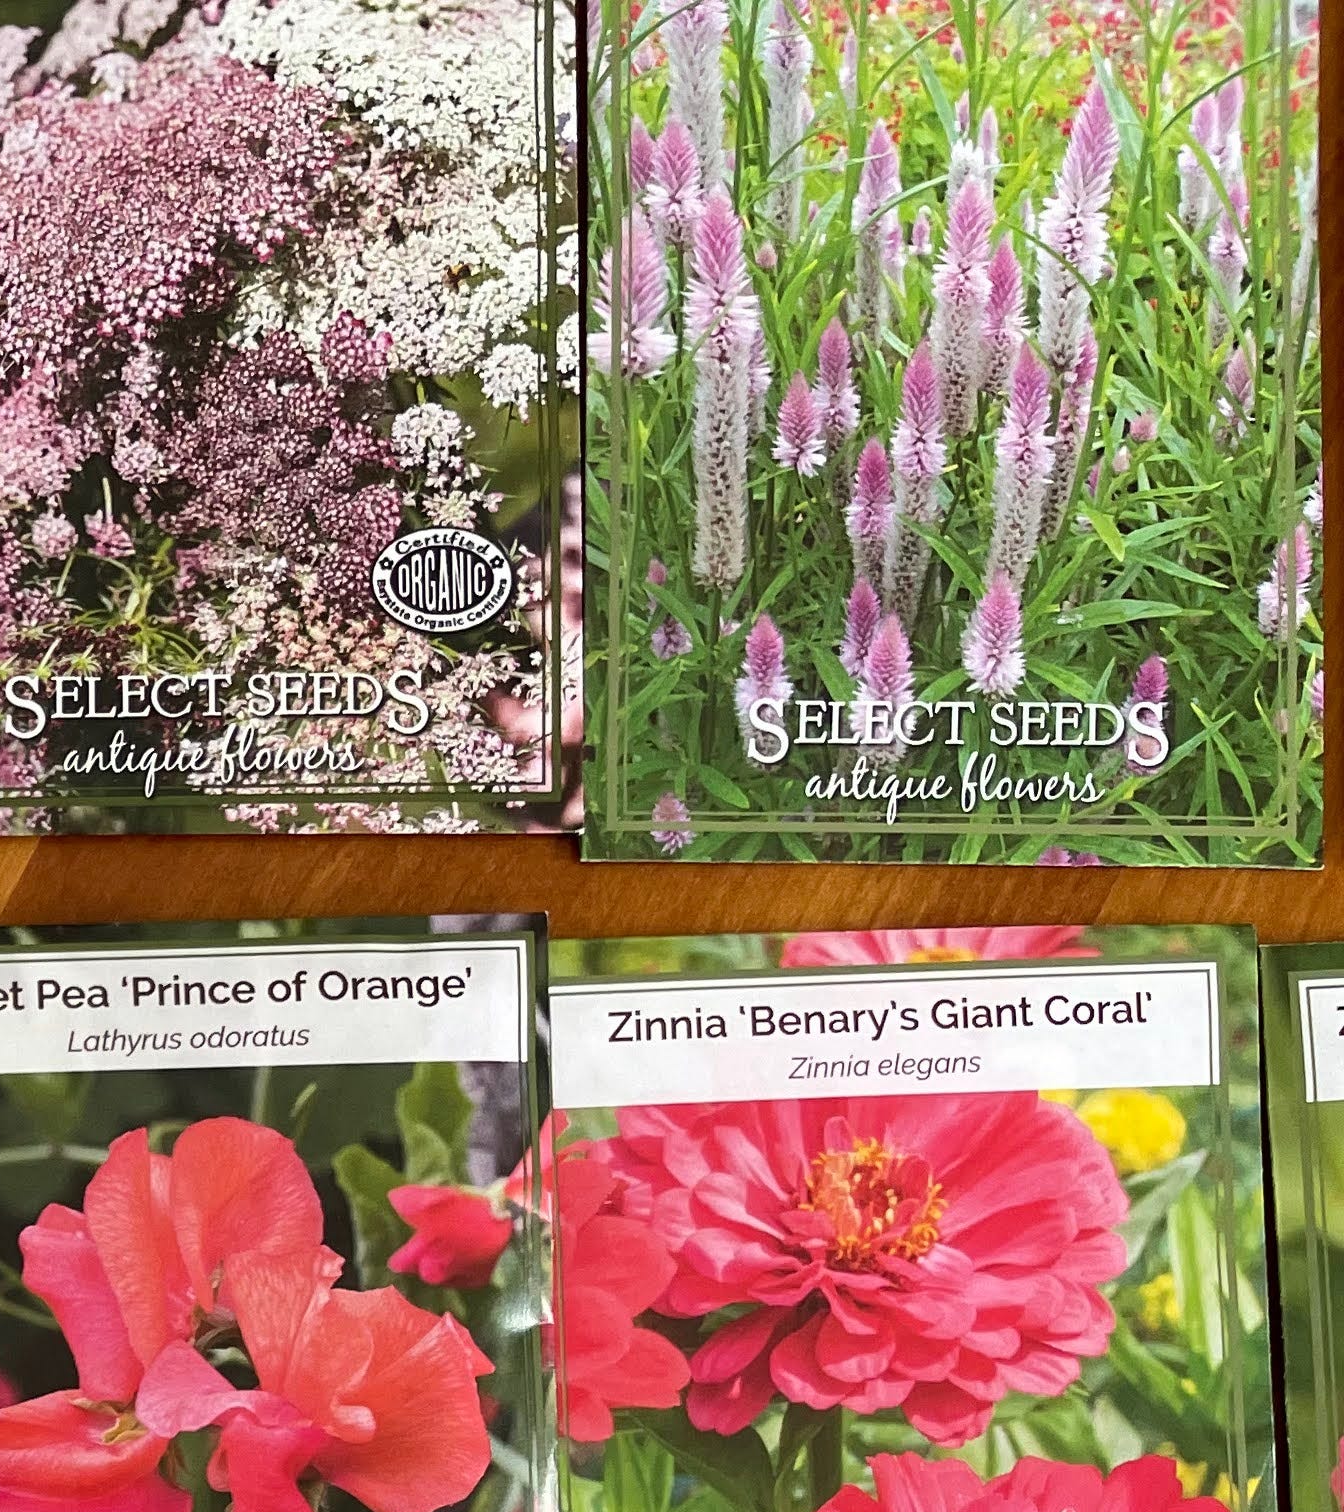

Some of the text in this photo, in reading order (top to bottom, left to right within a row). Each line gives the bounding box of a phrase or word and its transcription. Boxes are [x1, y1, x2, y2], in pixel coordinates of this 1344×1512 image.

[395, 532, 490, 555] Certified
[398, 549, 486, 611] ORGANIC
[5, 670, 429, 739] SELECT SEEDS
[746, 699, 1168, 766] SELECT SEEDS
[63, 724, 366, 797] antique flowers
[805, 752, 1106, 824] antique flowers
[37, 981, 110, 1010] Pea
[122, 975, 255, 1008] ‘Prince
[267, 971, 307, 1003] of
[318, 968, 472, 1008] Orange’
[67, 1024, 310, 1057] Lathyrus odoratus
[608, 992, 1152, 1043] Zinnia ‘Benary’s Giant Coral’
[788, 1053, 981, 1080] Zinnia elegans
